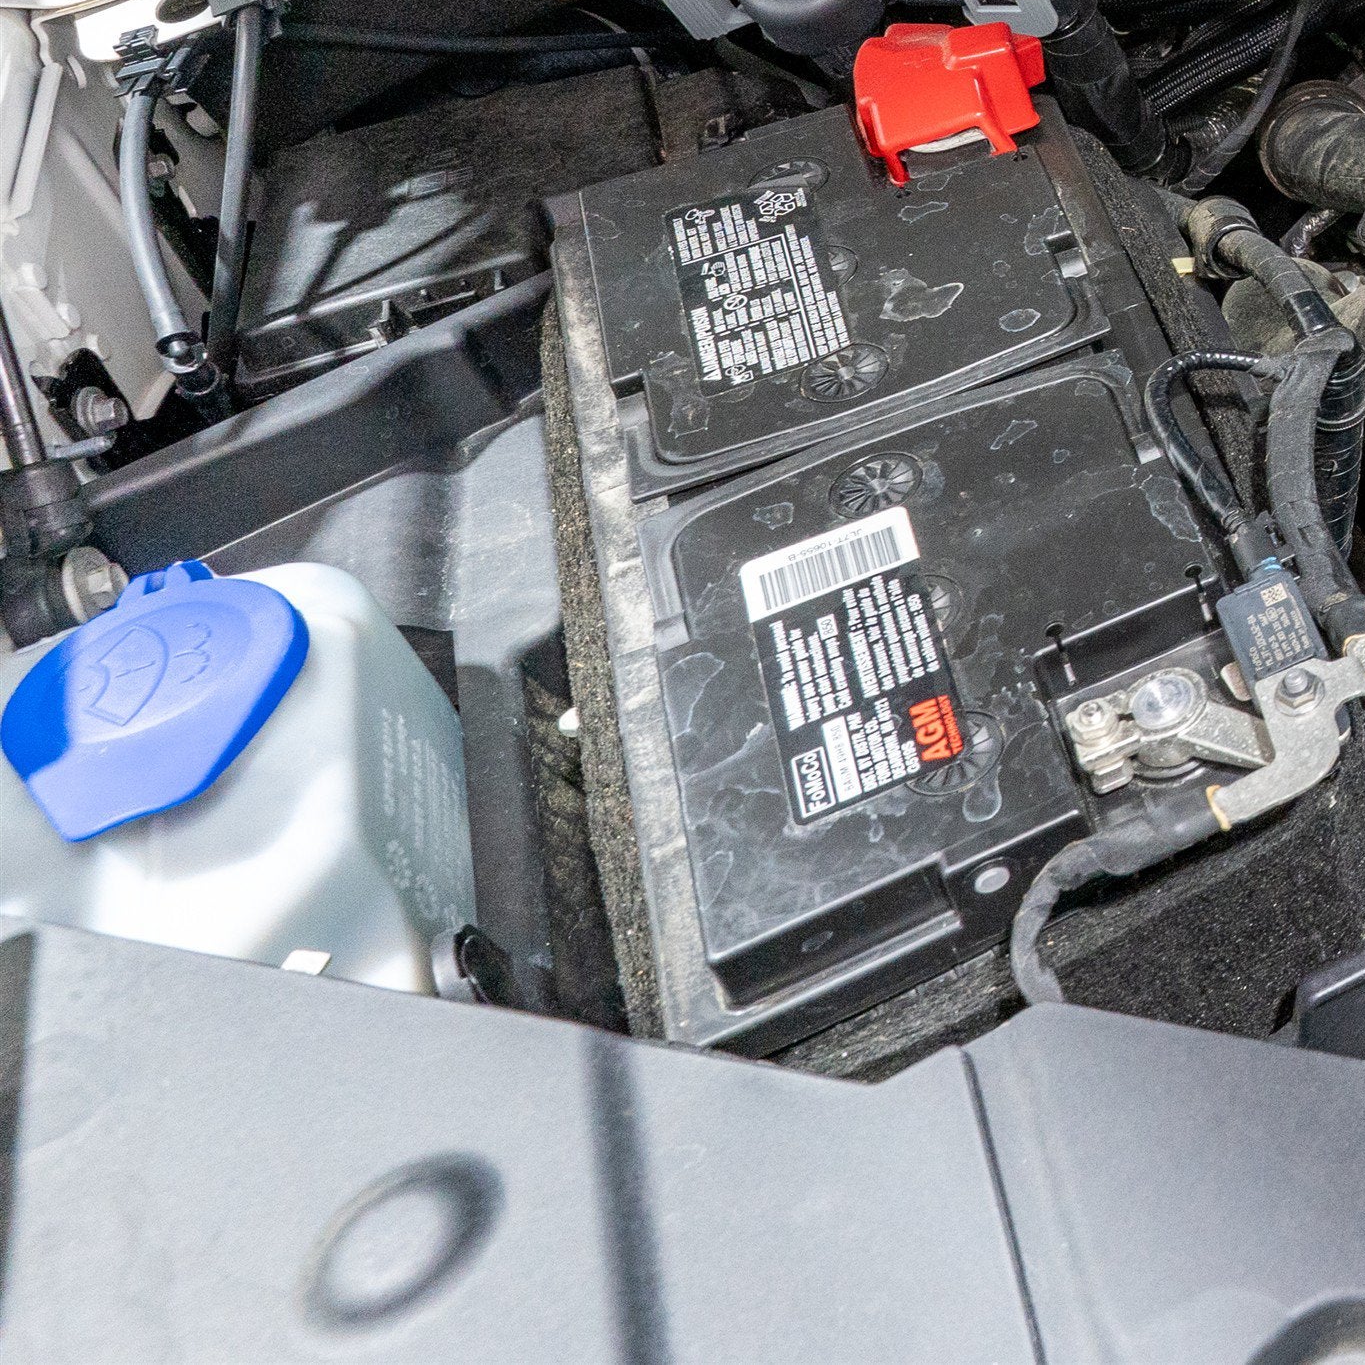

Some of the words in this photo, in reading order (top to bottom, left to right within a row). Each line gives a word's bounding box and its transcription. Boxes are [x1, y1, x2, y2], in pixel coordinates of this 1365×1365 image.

[691, 307, 719, 372] DANGER/POISON
[907, 594, 922, 612] 850
[769, 620, 790, 652] personal
[820, 617, 834, 635] 850
[830, 657, 848, 690] cranking
[836, 688, 853, 710] Cold
[874, 697, 892, 722] 48121
[846, 712, 863, 731] PAR
[864, 716, 879, 734] CO.
[880, 720, 895, 734] MI
[910, 700, 950, 760] AGM
[938, 695, 962, 754] TECHNOLOGY
[867, 731, 886, 763] MOTOR
[884, 731, 907, 779] DEARBORN,
[857, 756, 873, 771] BY
[874, 760, 892, 786] FORD
[800, 752, 827, 811] FoMoCo
[860, 768, 879, 792] DIST.
